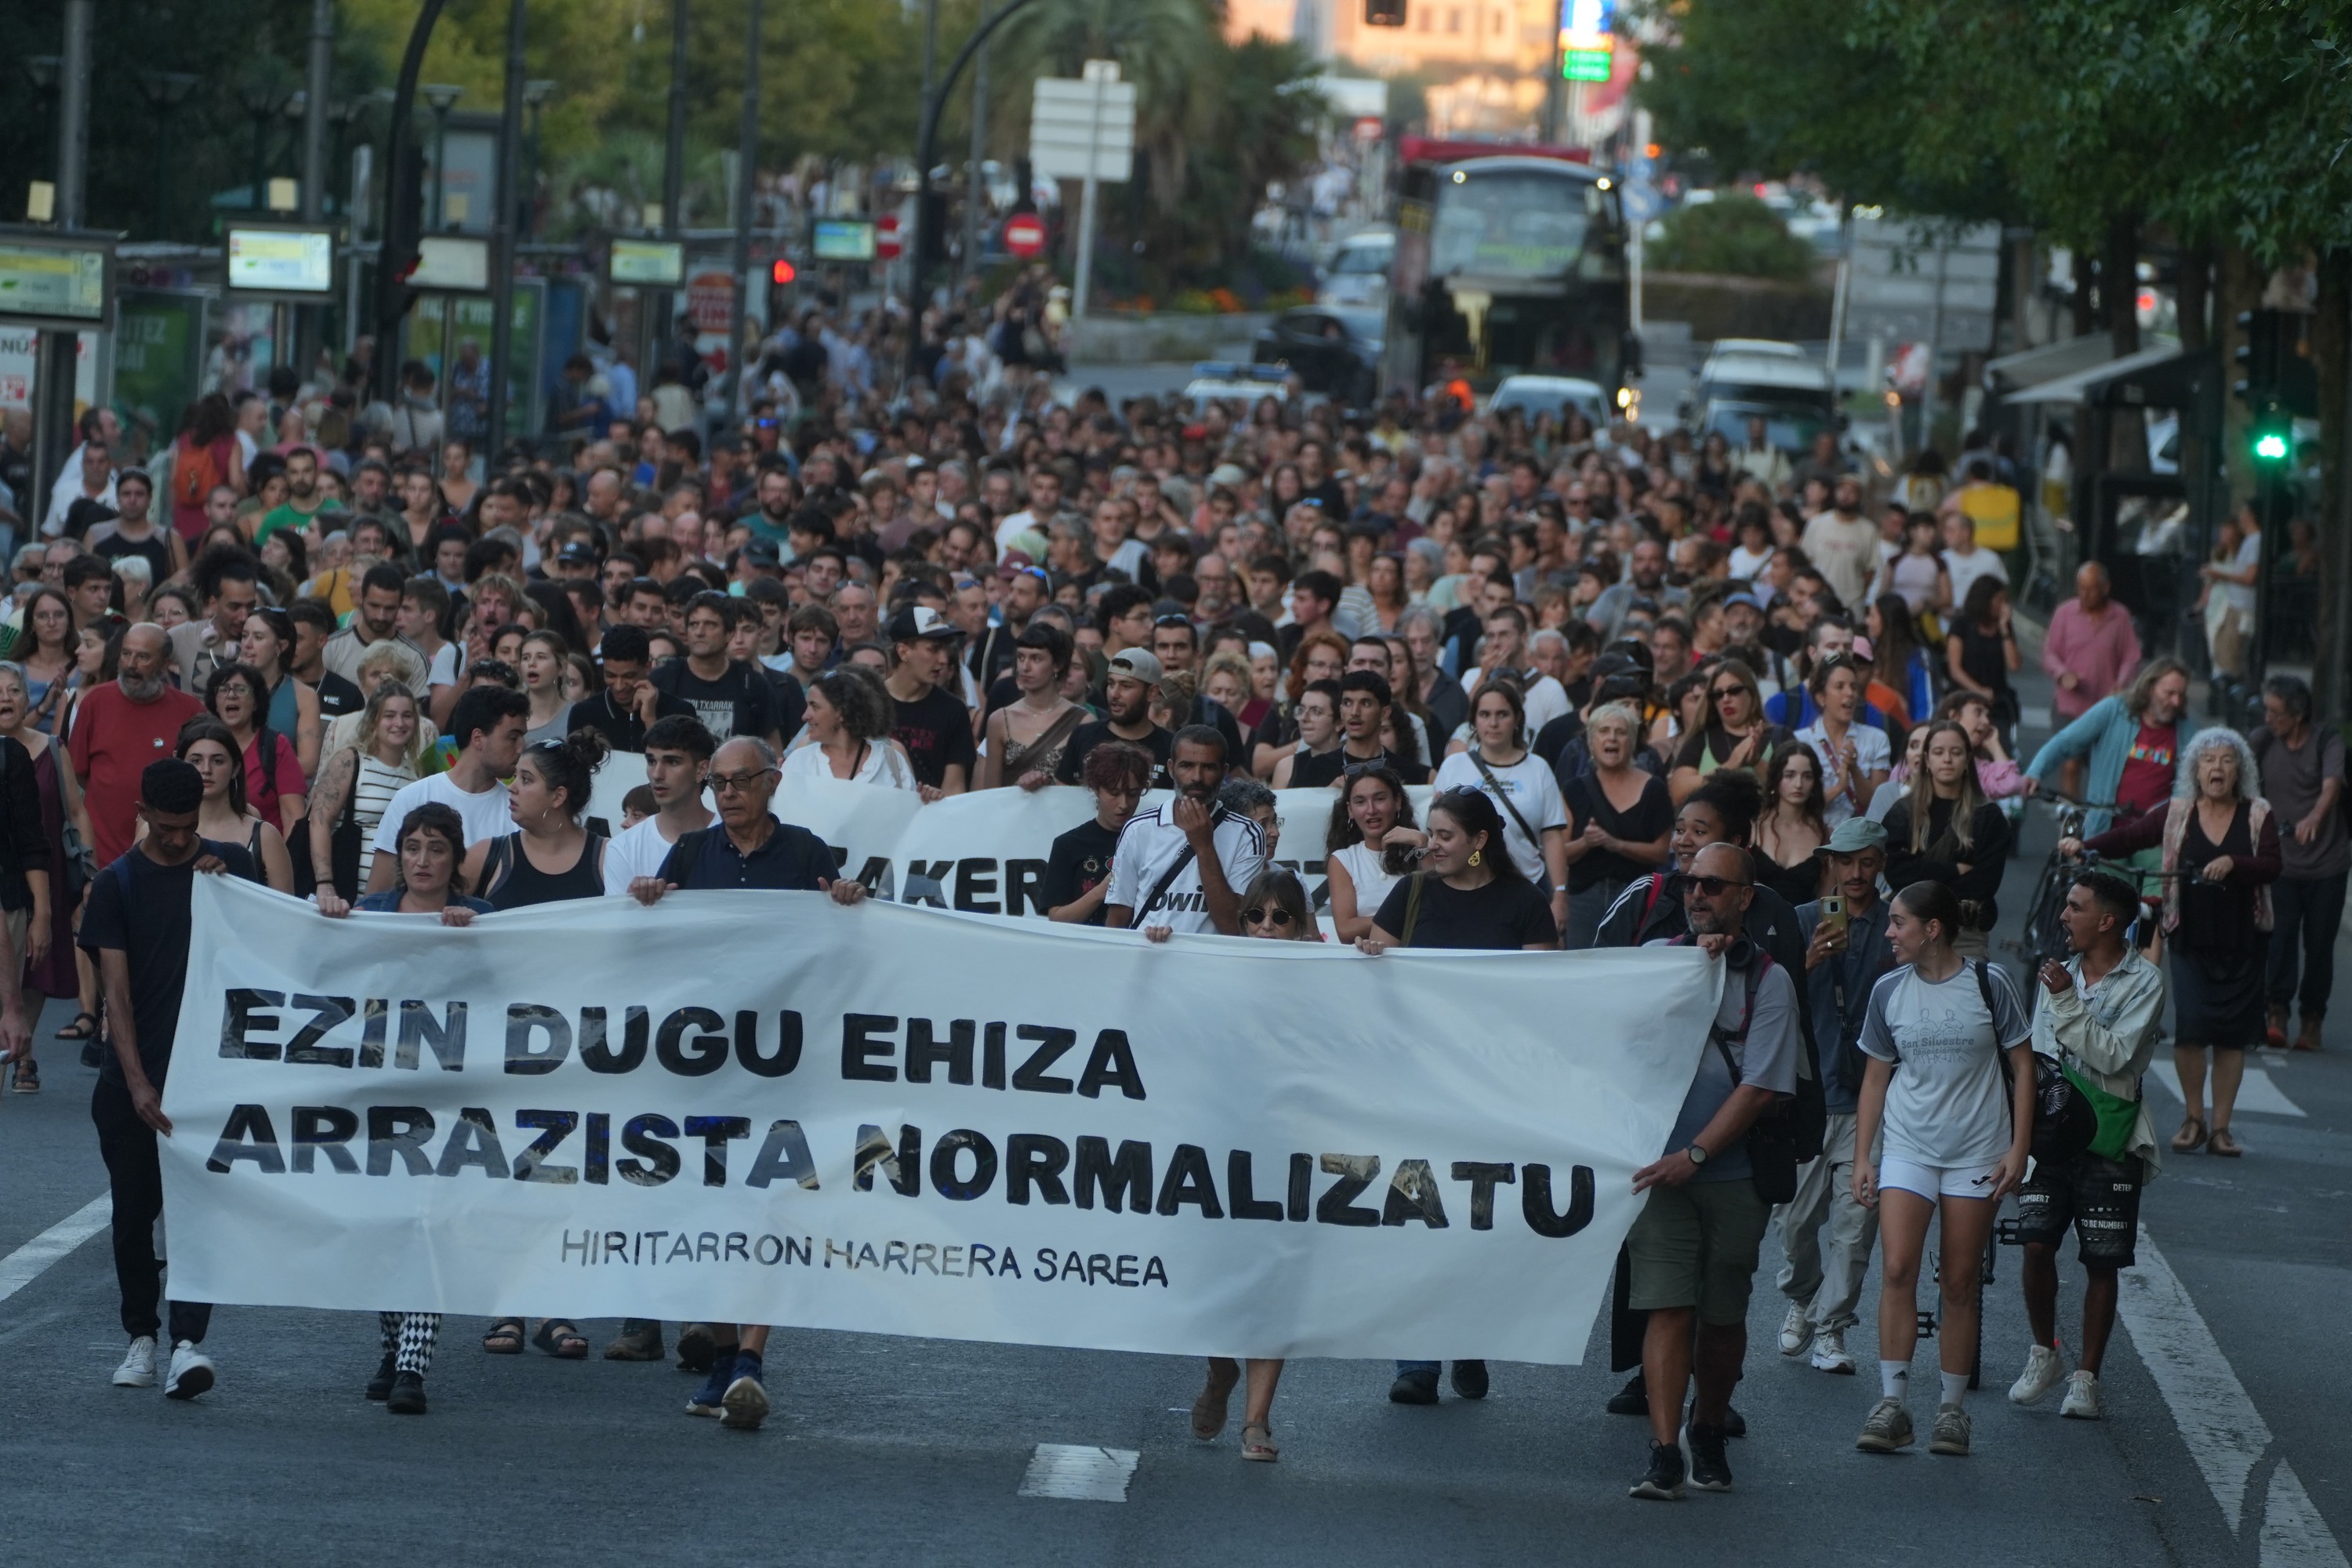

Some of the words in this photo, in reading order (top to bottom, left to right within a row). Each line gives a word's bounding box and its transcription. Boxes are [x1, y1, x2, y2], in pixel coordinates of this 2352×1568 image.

[0, 333, 30, 354] NÚ
[827, 846, 1048, 916] AKER
[218, 988, 468, 1072] EZIN
[504, 1002, 803, 1078] DUGU
[841, 1013, 1147, 1101] EHIZA
[1901, 1040, 1918, 1049] San
[205, 1104, 820, 1191] ARRAZISTA
[852, 1123, 1595, 1238] NORMALIZATU
[2089, 1220, 2098, 1229] BE
[2098, 1220, 2124, 1229] NUMBER
[562, 1229, 812, 1267] HIRITARRON
[824, 1238, 1022, 1279] HARRERA
[1034, 1248, 1168, 1288] SAREA
